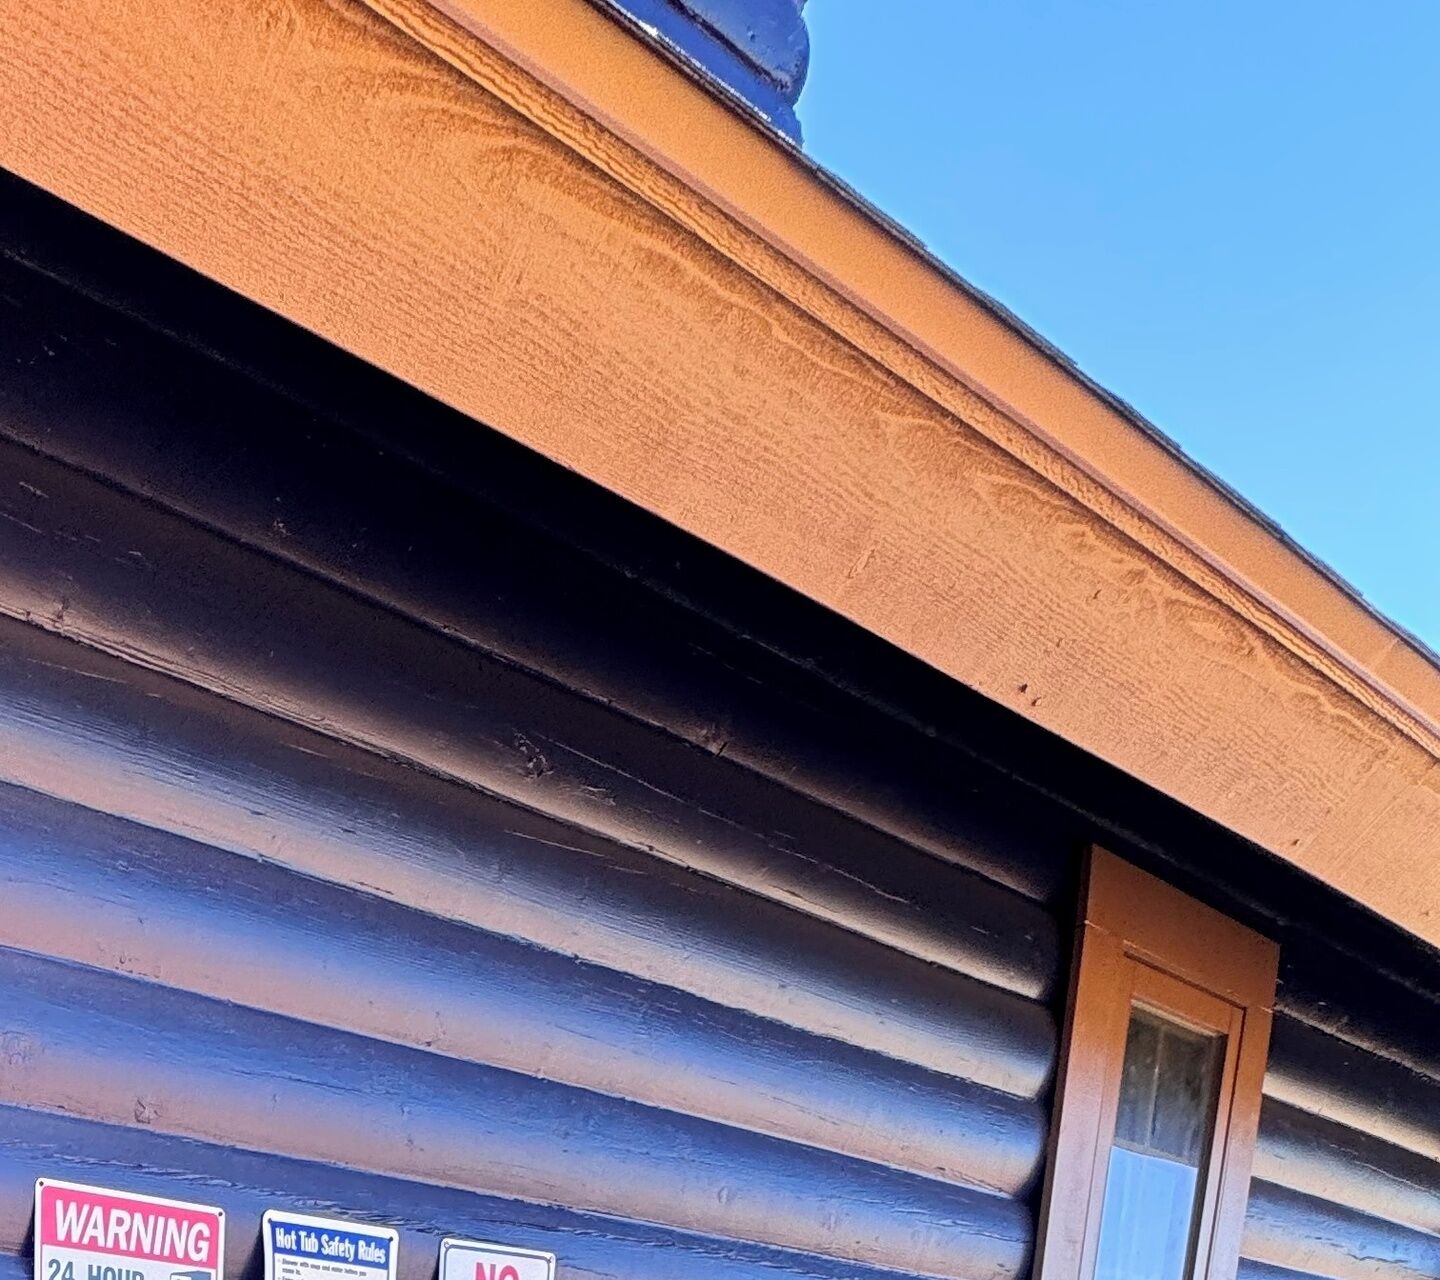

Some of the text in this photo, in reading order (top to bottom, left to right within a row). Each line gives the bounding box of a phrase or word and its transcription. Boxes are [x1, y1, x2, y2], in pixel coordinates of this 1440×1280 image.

[55, 1200, 210, 1262] WARNING
[276, 1227, 385, 1263] Hot Tub Safety Rules
